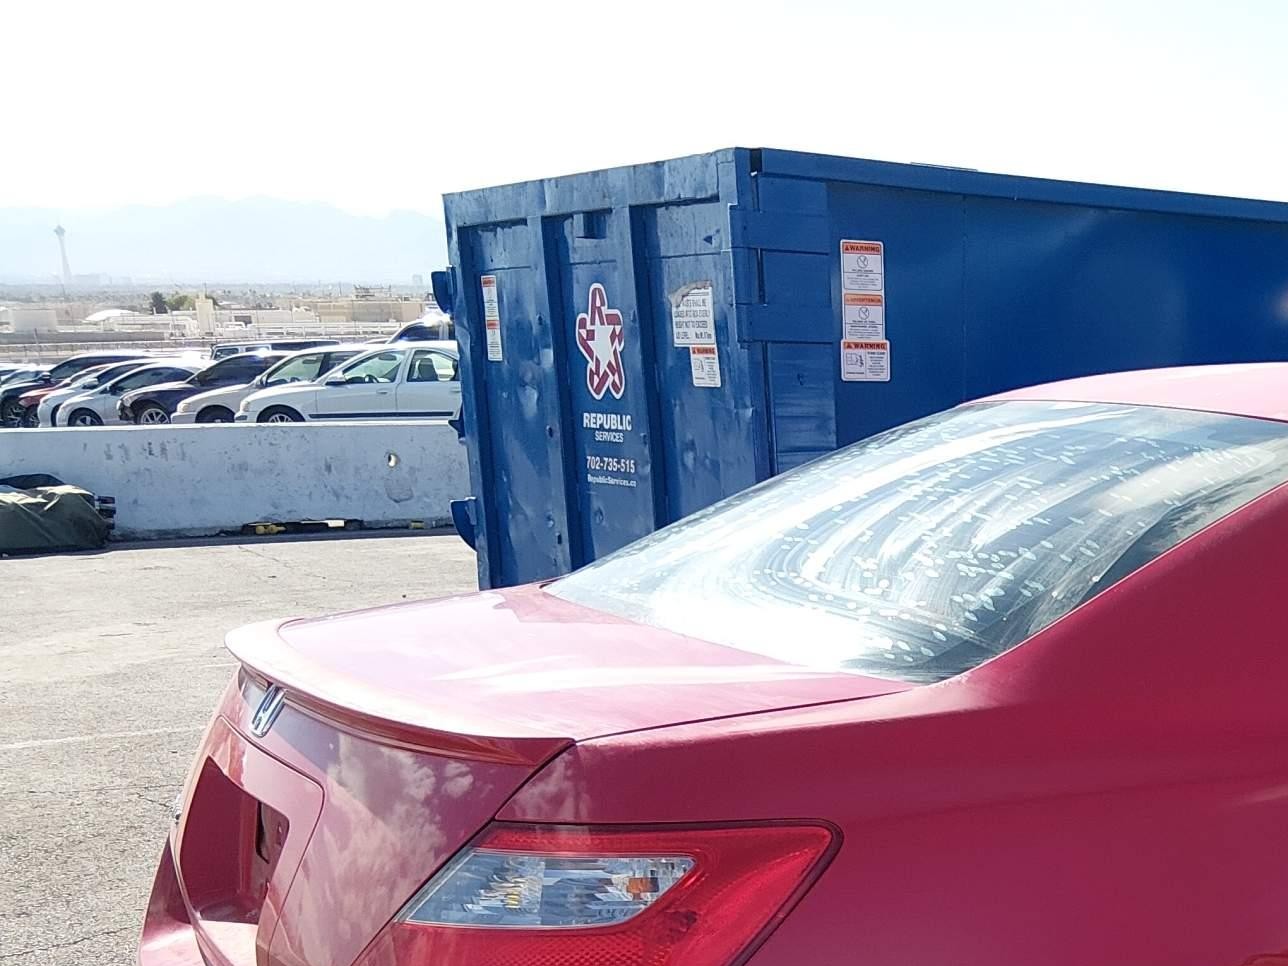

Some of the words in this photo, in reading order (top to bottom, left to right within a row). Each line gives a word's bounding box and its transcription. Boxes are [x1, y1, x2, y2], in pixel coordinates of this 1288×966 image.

[583, 412, 633, 431] REPUBLIC
[594, 431, 624, 443] SERVICES
[586, 456, 636, 474] 702-735-515
